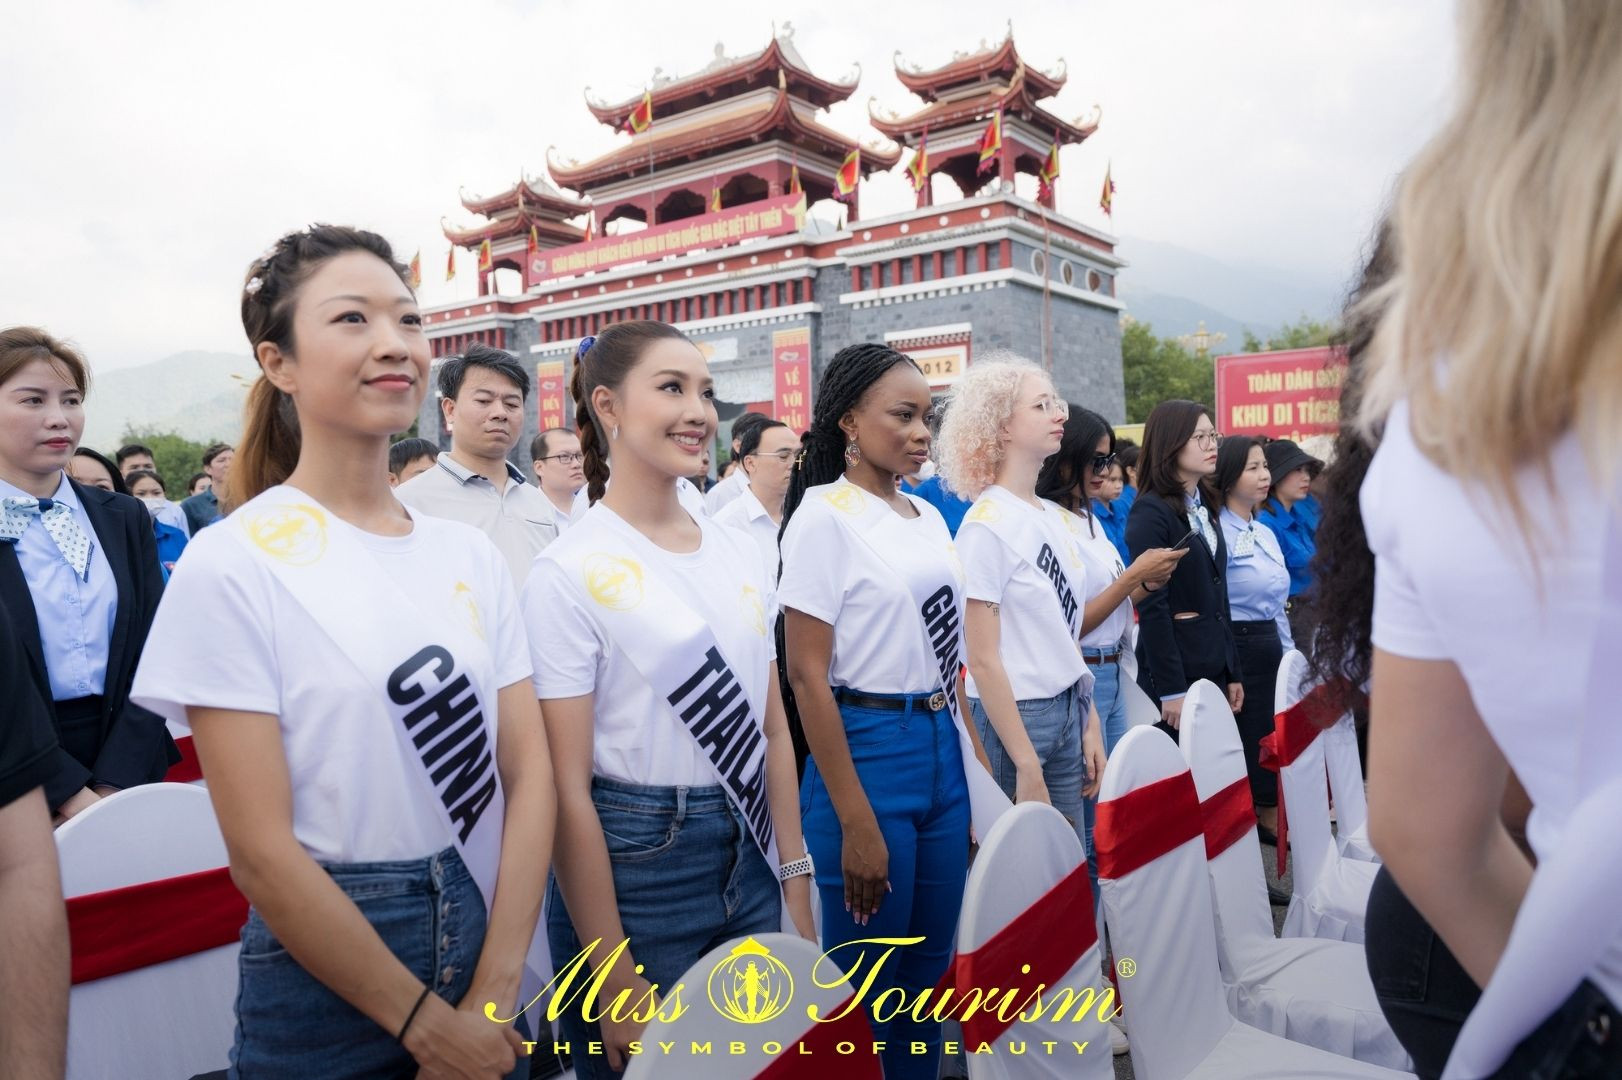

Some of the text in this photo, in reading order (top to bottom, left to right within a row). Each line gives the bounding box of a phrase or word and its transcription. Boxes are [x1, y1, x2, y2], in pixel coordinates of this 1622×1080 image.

[923, 360, 953, 376] 012
[1247, 370, 1283, 393] TOÀN
[1284, 366, 1314, 391] DÂN
[1231, 403, 1269, 428] KHU
[1273, 402, 1293, 426] DI
[1036, 542, 1078, 626] GREAT
[387, 645, 497, 846] CHINA
[666, 645, 774, 856] THAILAND
